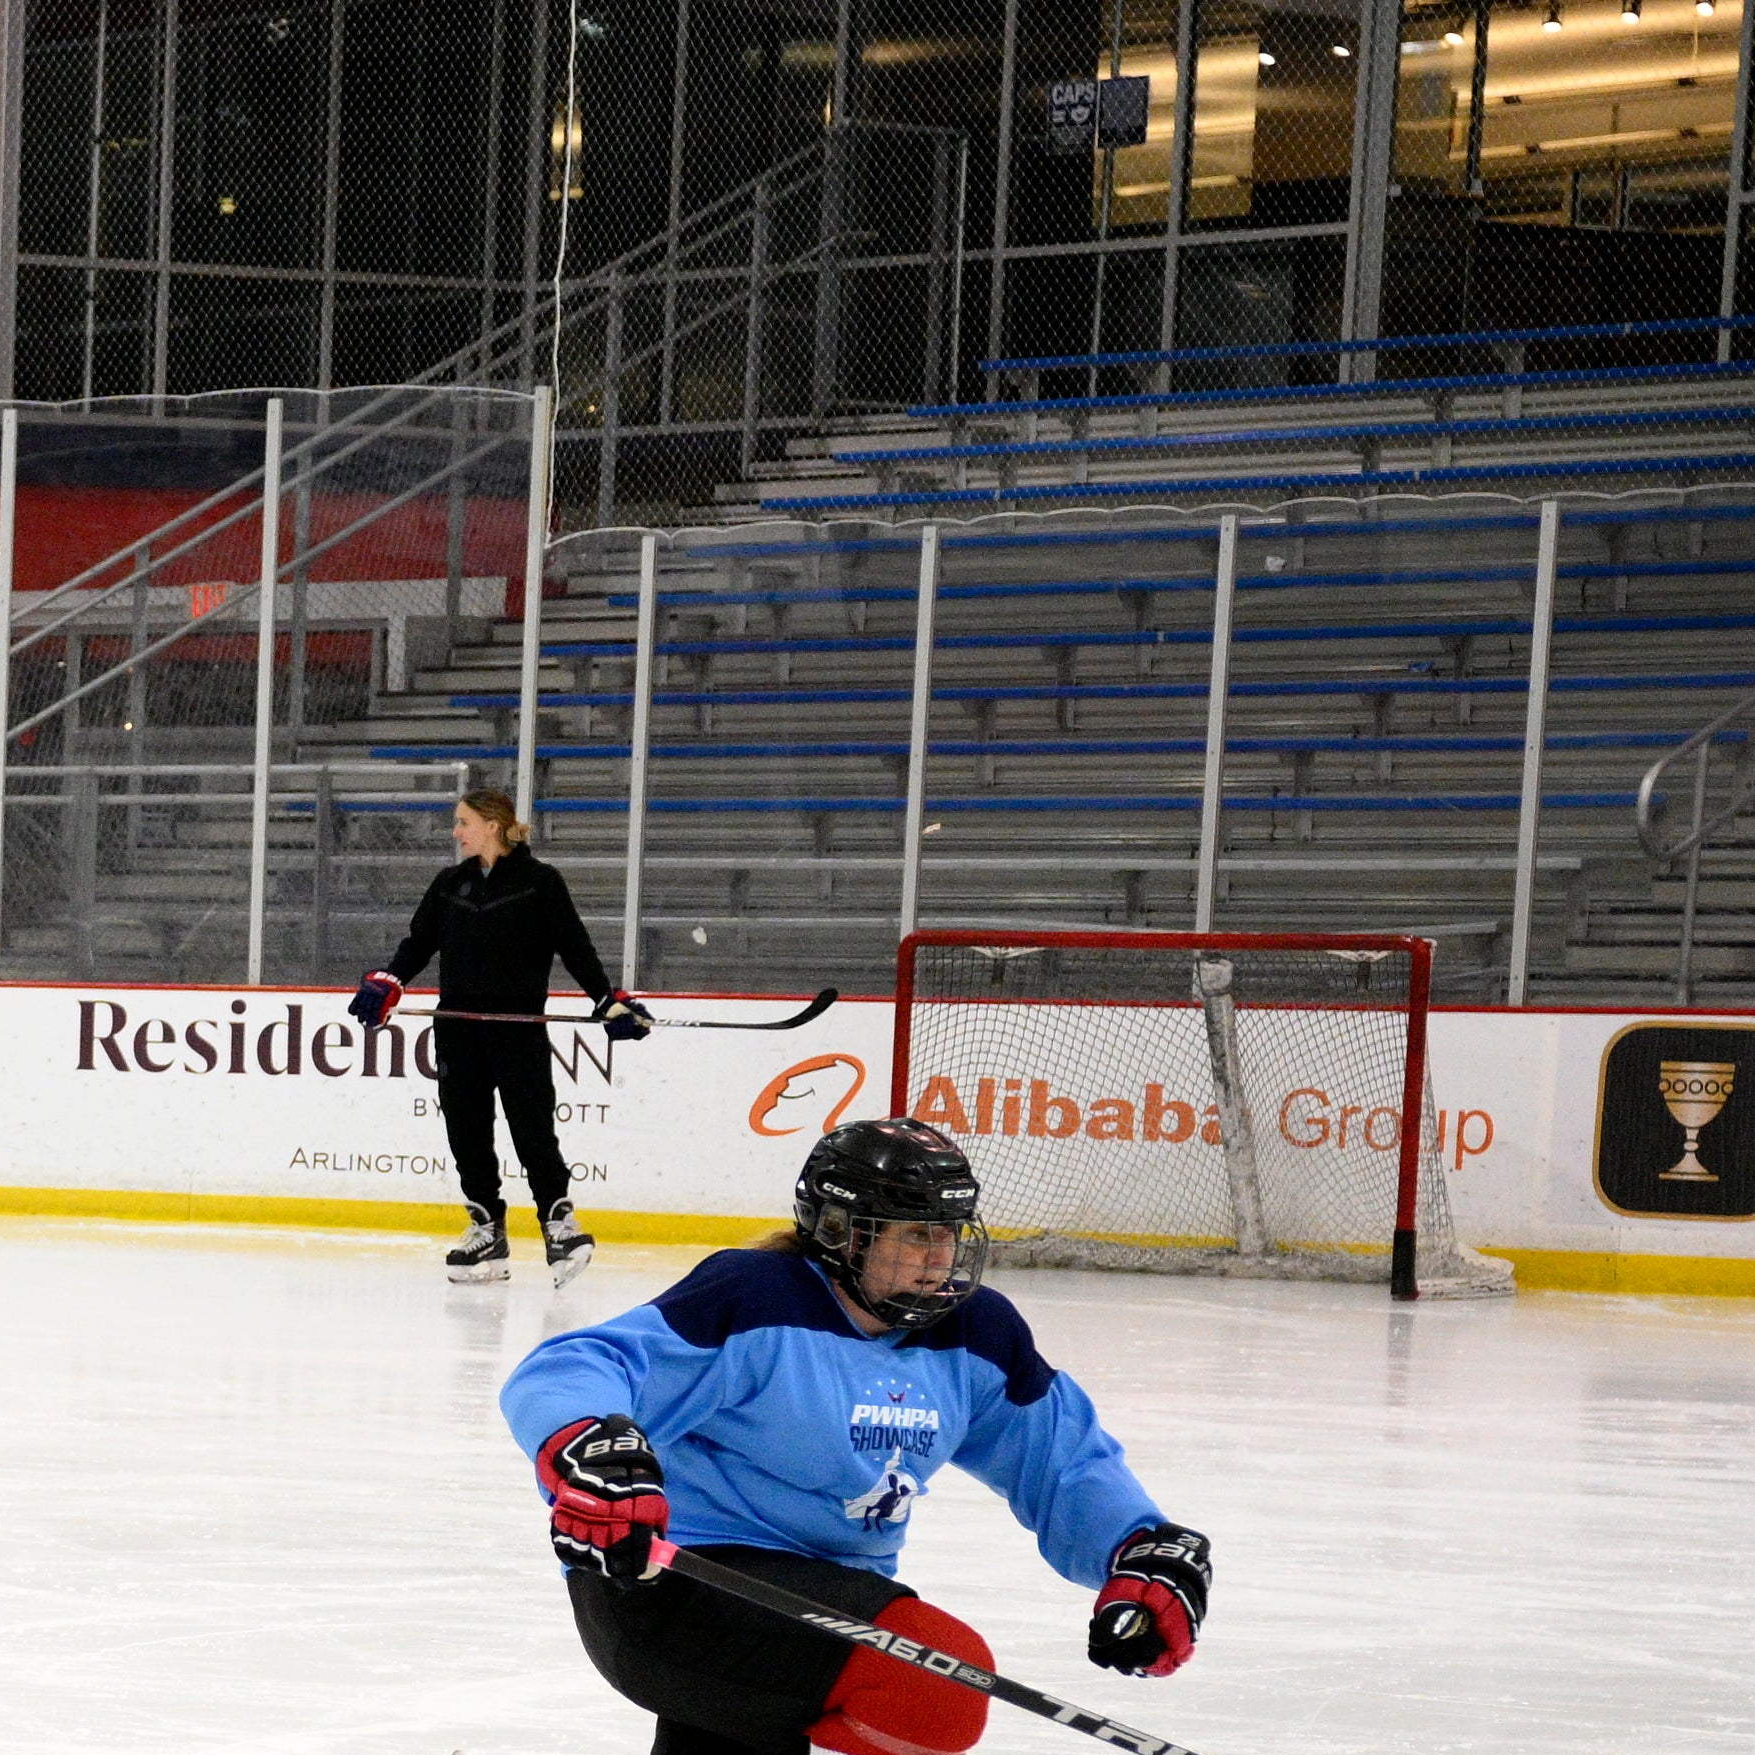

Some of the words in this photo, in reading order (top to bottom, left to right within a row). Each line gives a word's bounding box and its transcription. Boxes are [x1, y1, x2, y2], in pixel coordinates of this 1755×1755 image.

[1050, 82, 1096, 106] CAPS
[288, 1146, 447, 1176] ARLINGTON
[821, 1181, 858, 1201] CCM
[940, 1187, 976, 1200] CCM
[850, 1404, 939, 1429] PWHPA
[850, 1425, 938, 1458] SHOWCASE
[1176, 1533, 1203, 1548] 25
[860, 1628, 960, 1677] A6.0
